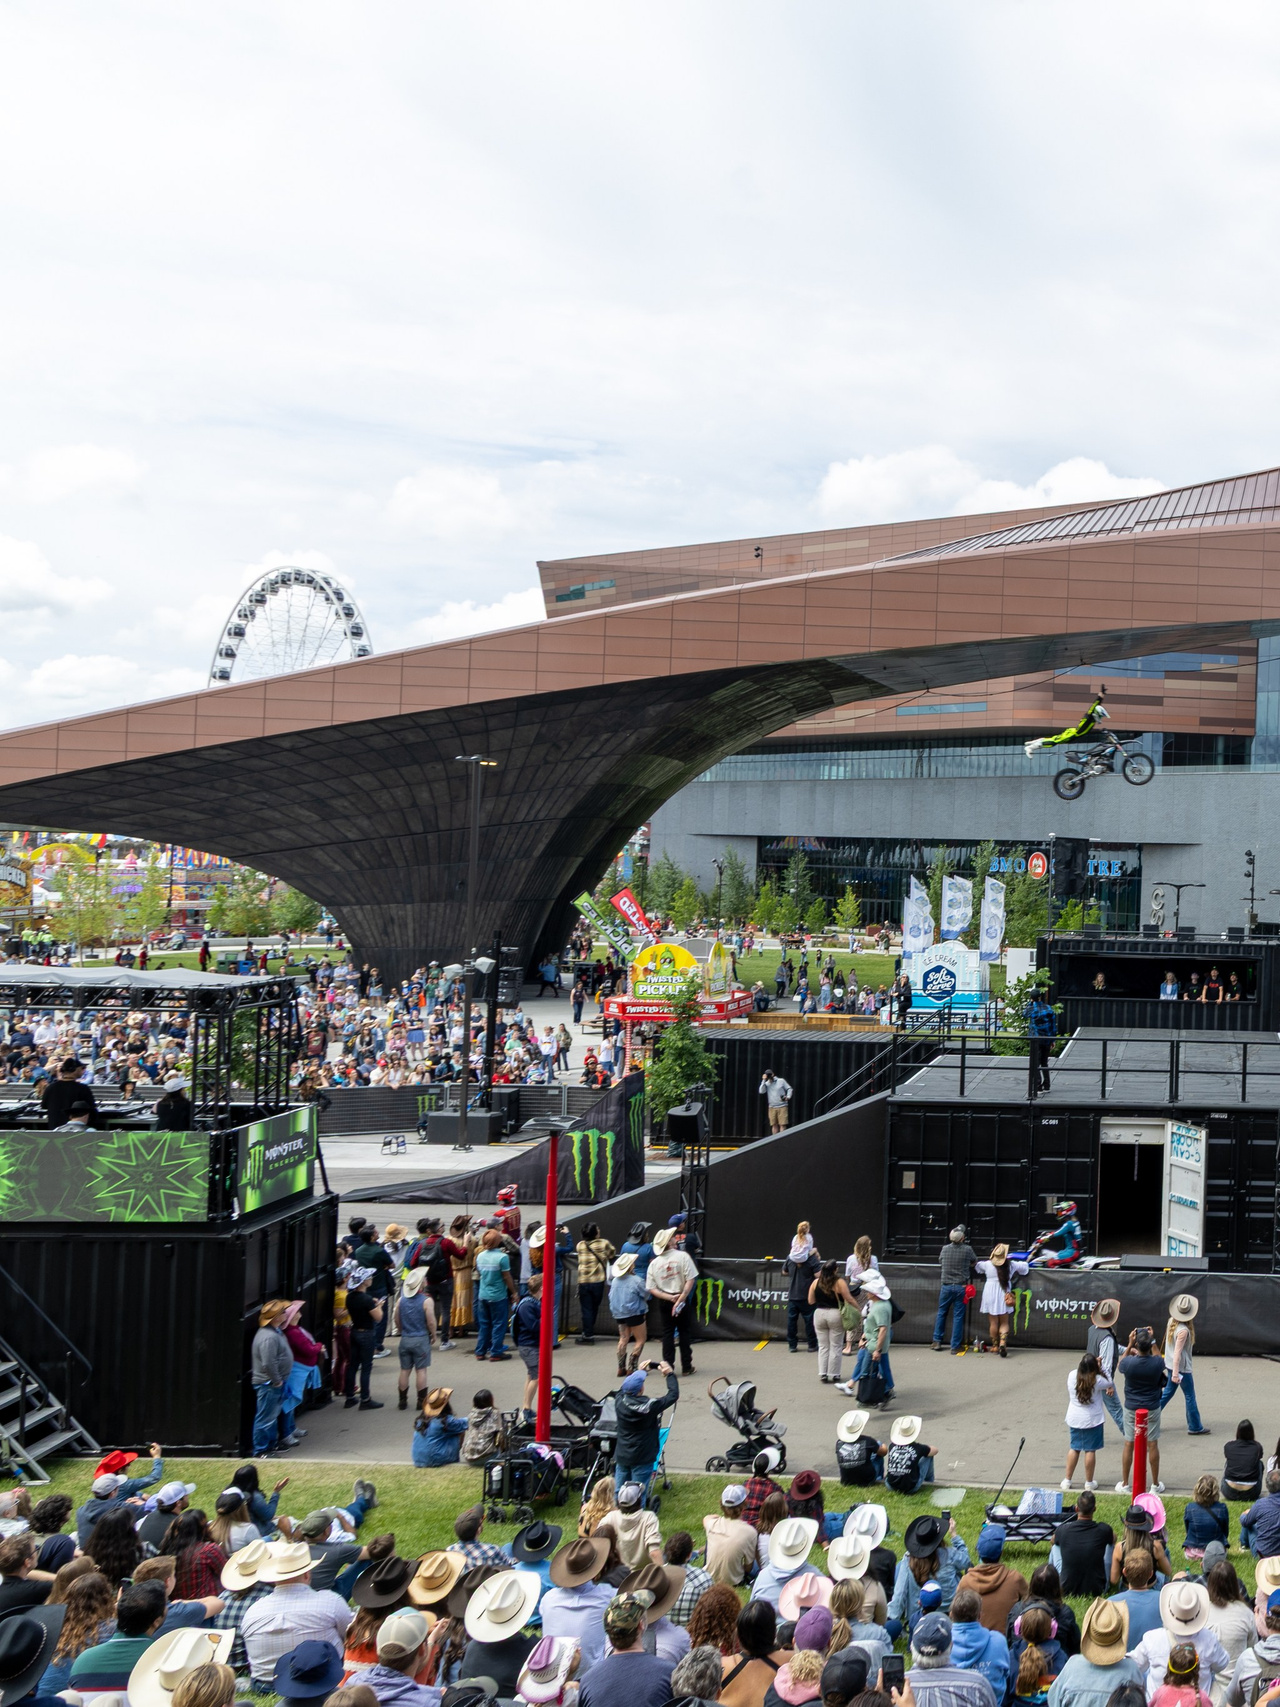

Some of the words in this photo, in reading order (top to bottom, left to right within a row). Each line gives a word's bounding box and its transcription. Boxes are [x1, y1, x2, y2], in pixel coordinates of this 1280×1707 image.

[989, 857, 1026, 873] BMO
[619, 896, 657, 945] WISTED
[645, 975, 684, 984] TWISTED
[625, 1006, 659, 1014] TWISTED
[265, 1138, 304, 1161] MONSTER
[727, 1287, 790, 1302] MONSTE
[737, 1302, 788, 1310] ENERGY
[1035, 1297, 1098, 1313] MONSTE
